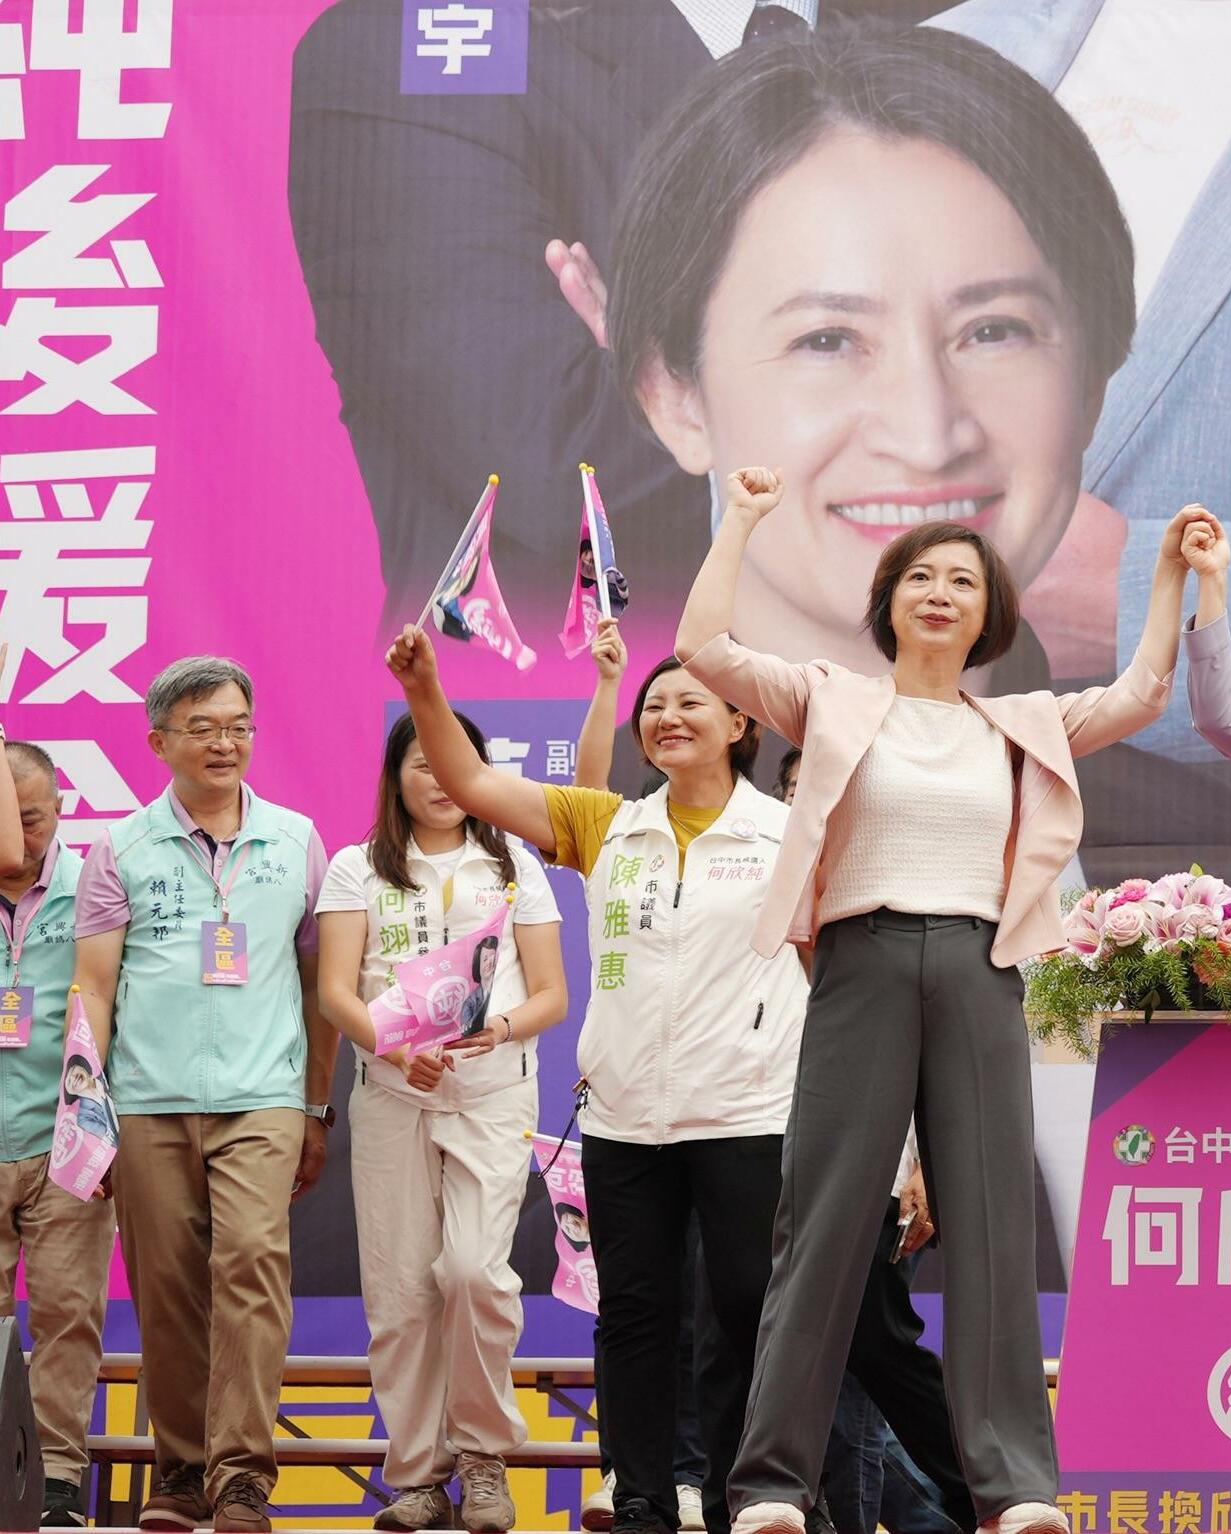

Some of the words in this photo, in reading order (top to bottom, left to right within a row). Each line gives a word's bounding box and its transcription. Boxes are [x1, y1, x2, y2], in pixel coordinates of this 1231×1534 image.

[417, 4, 494, 74] 宇
[707, 866, 765, 881] 何欣純
[596, 854, 645, 991] 陳雅惠
[640, 879, 659, 931] 市議員
[214, 927, 236, 970] 全區
[377, 886, 411, 988] 何翊
[1, 991, 23, 1034] 全區
